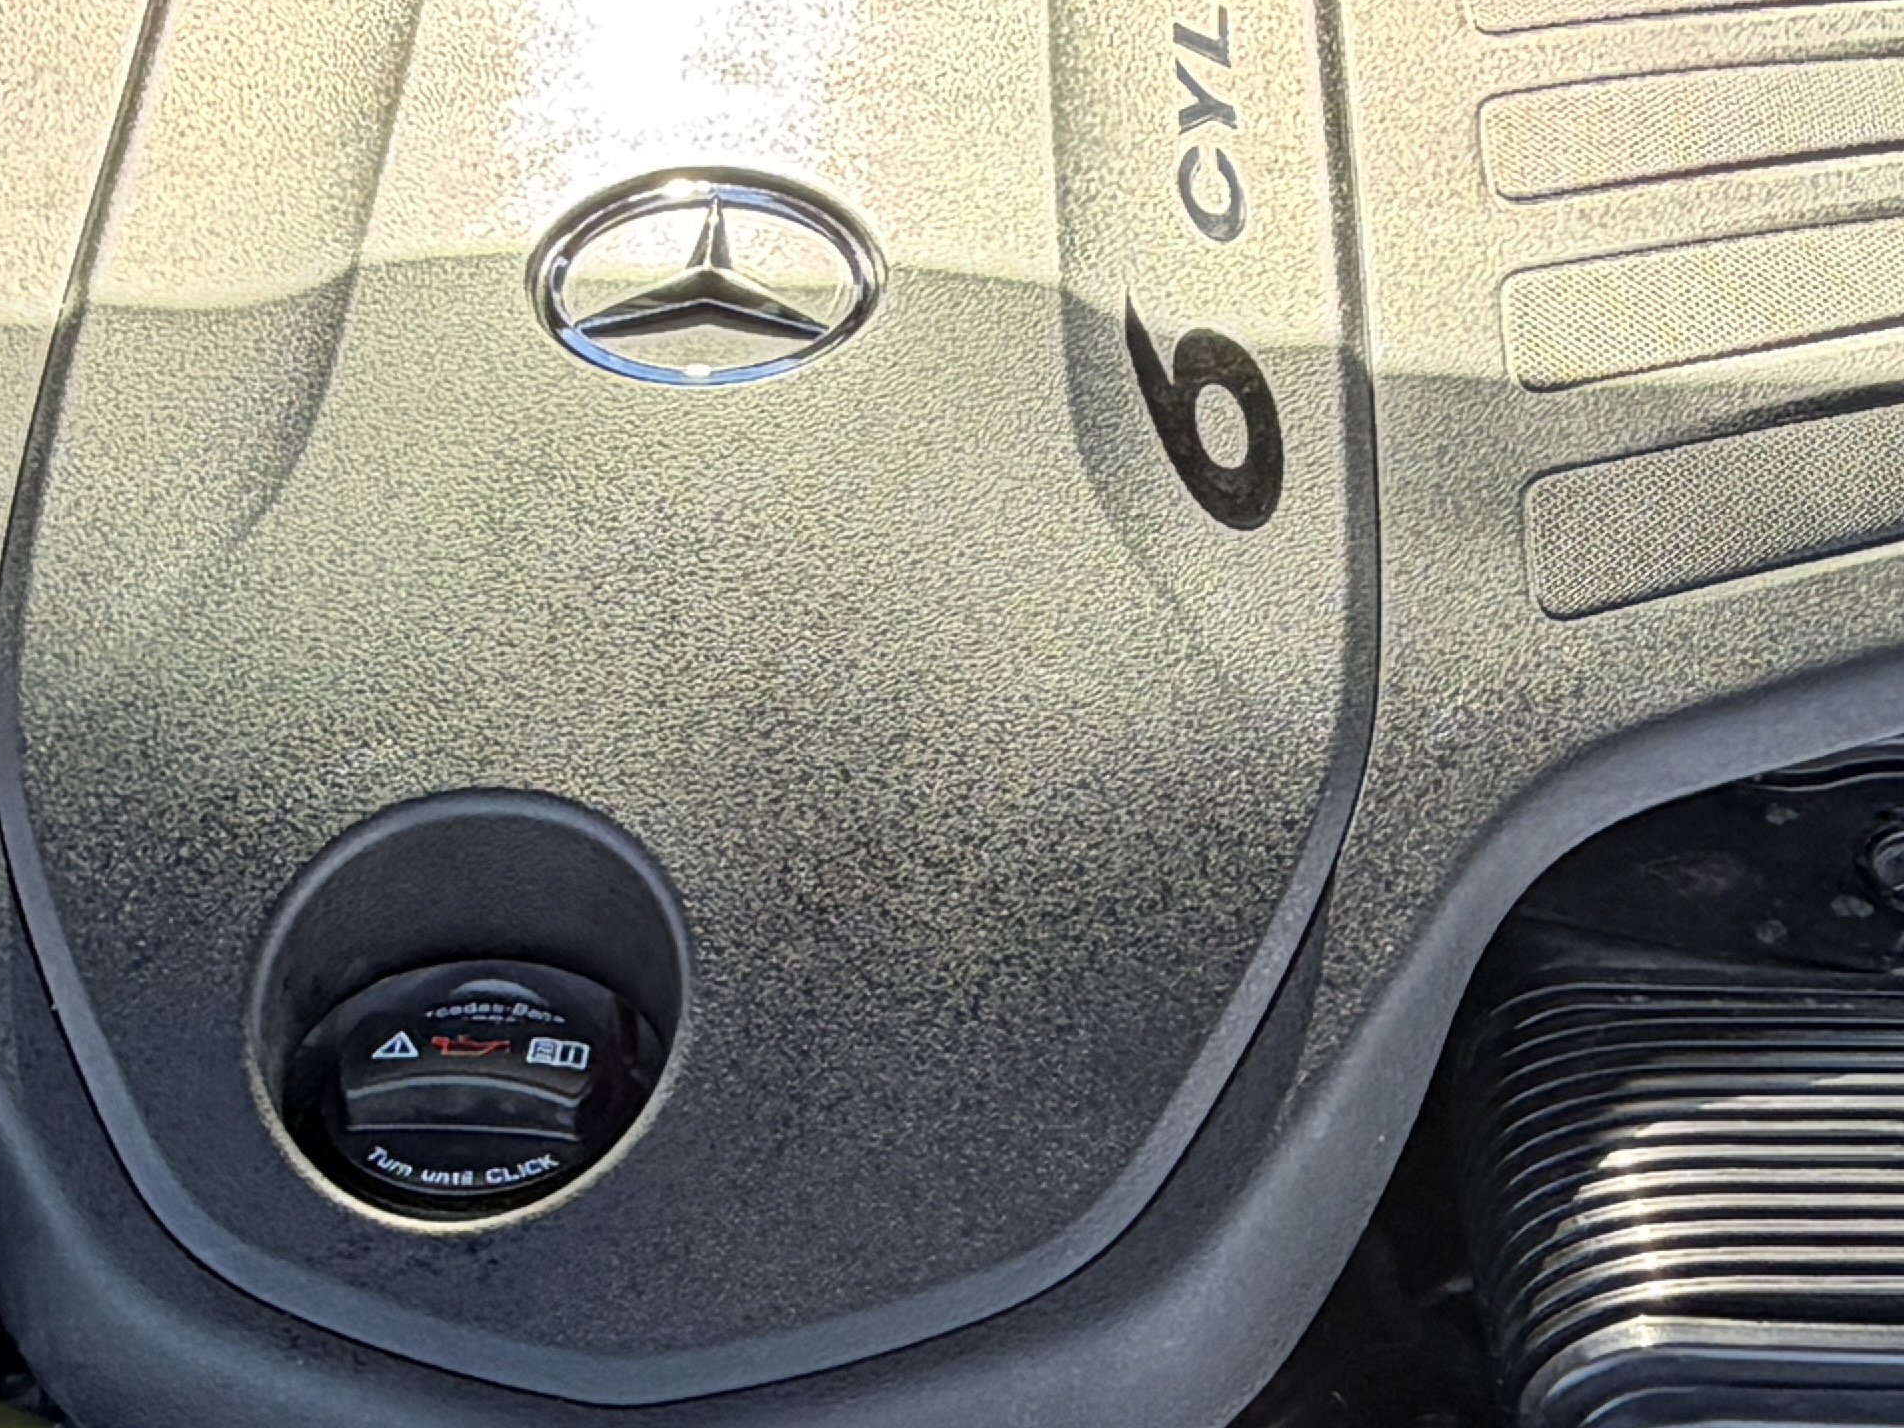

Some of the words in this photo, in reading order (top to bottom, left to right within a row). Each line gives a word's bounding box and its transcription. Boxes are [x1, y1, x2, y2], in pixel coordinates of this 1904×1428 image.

[1124, 283, 1285, 532] 6
[366, 1146, 414, 1178] Turn
[420, 1169, 474, 1186] until
[486, 1152, 561, 1184] CLICK
